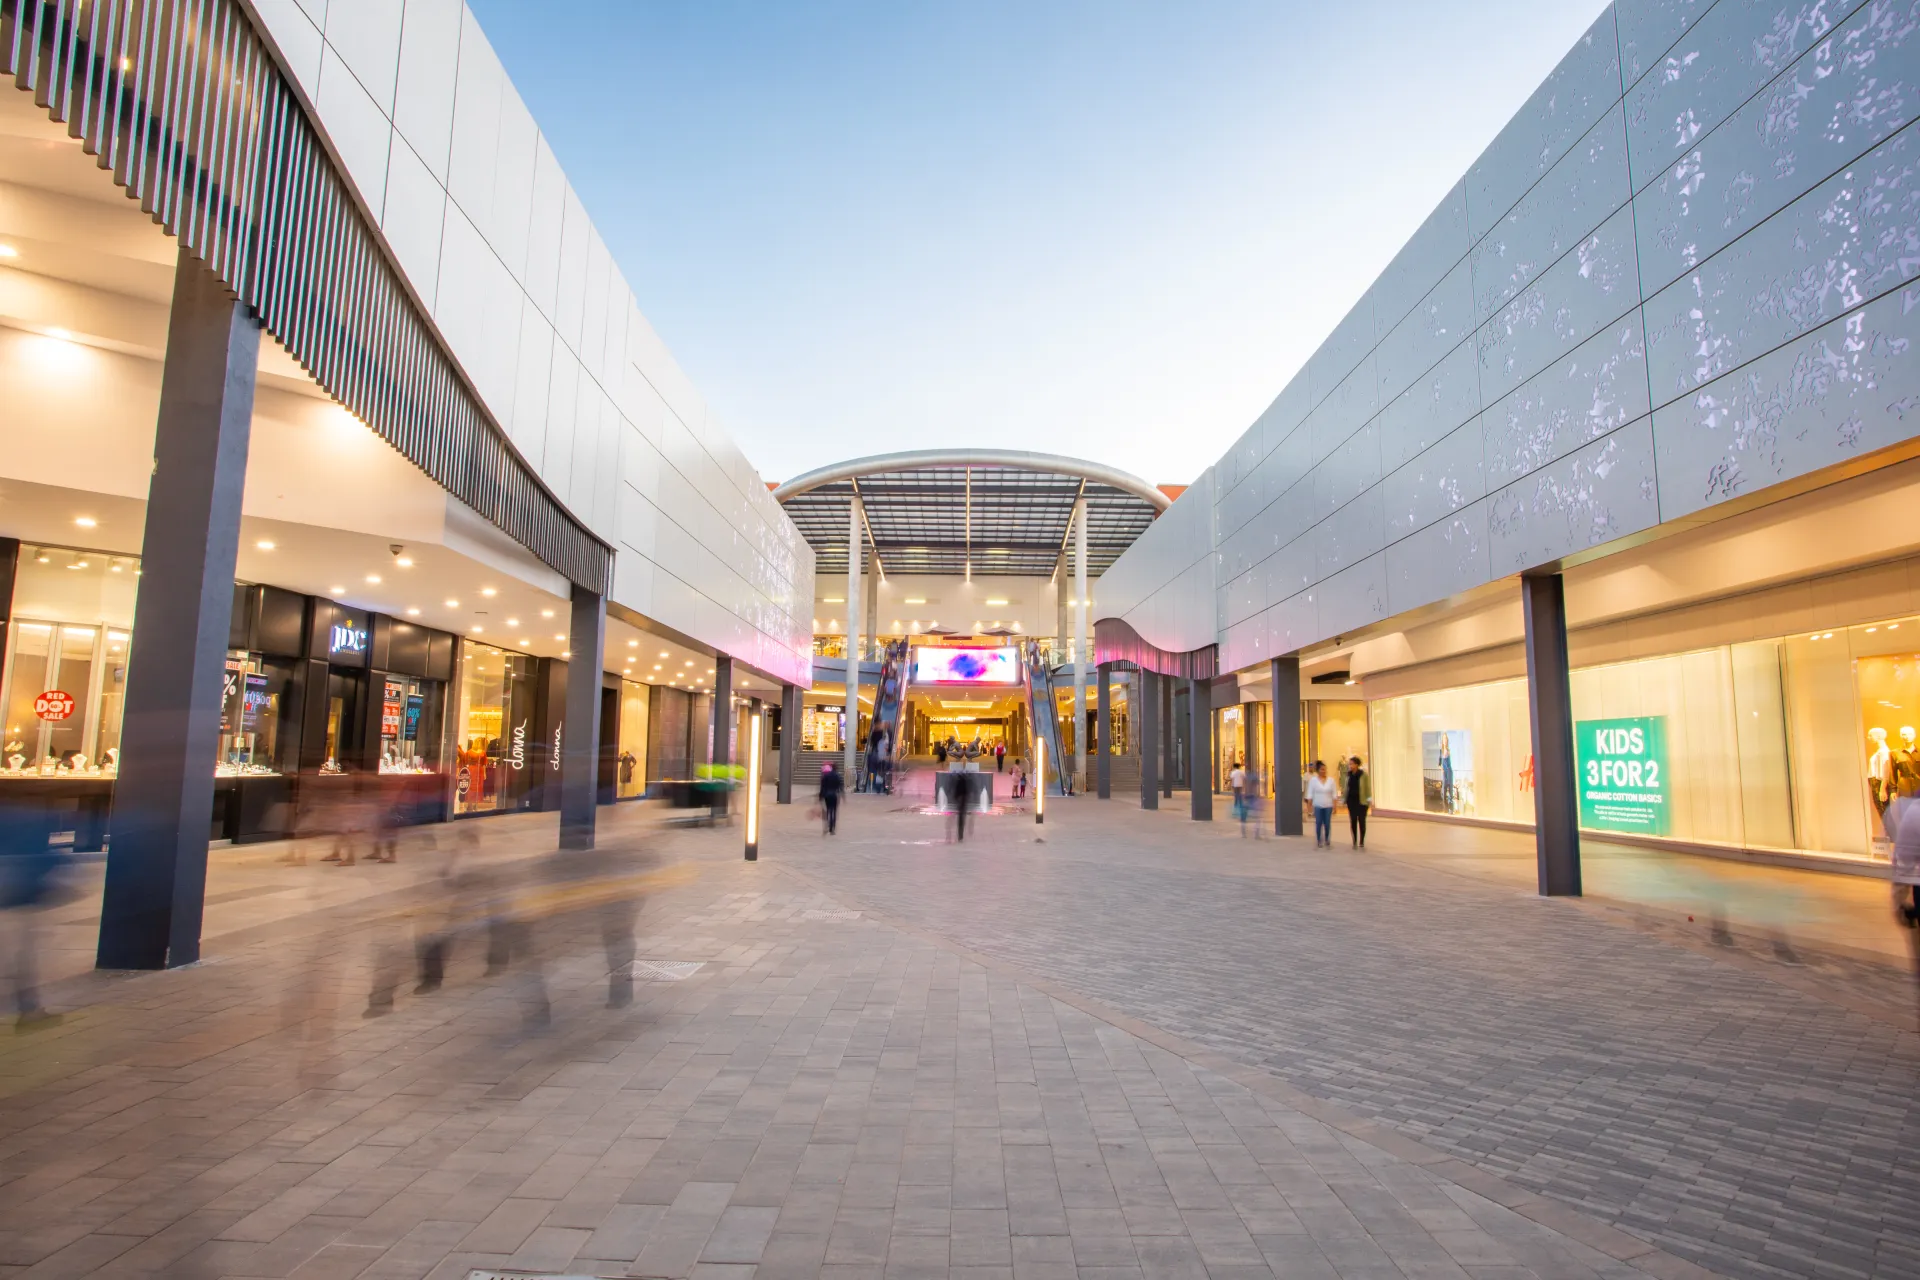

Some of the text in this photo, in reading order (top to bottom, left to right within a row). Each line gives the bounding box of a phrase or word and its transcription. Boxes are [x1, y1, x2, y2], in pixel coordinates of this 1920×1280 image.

[331, 625, 368, 653] JDC
[36, 700, 73, 713] DOT
[43, 712, 64, 720] SALE
[503, 717, 527, 770] donna
[550, 721, 562, 771] donna
[1596, 728, 1644, 754] KIDS
[1586, 759, 1660, 788] 3 FOR 2
[1586, 791, 1662, 804] ORGANIC COTTON BASICS
